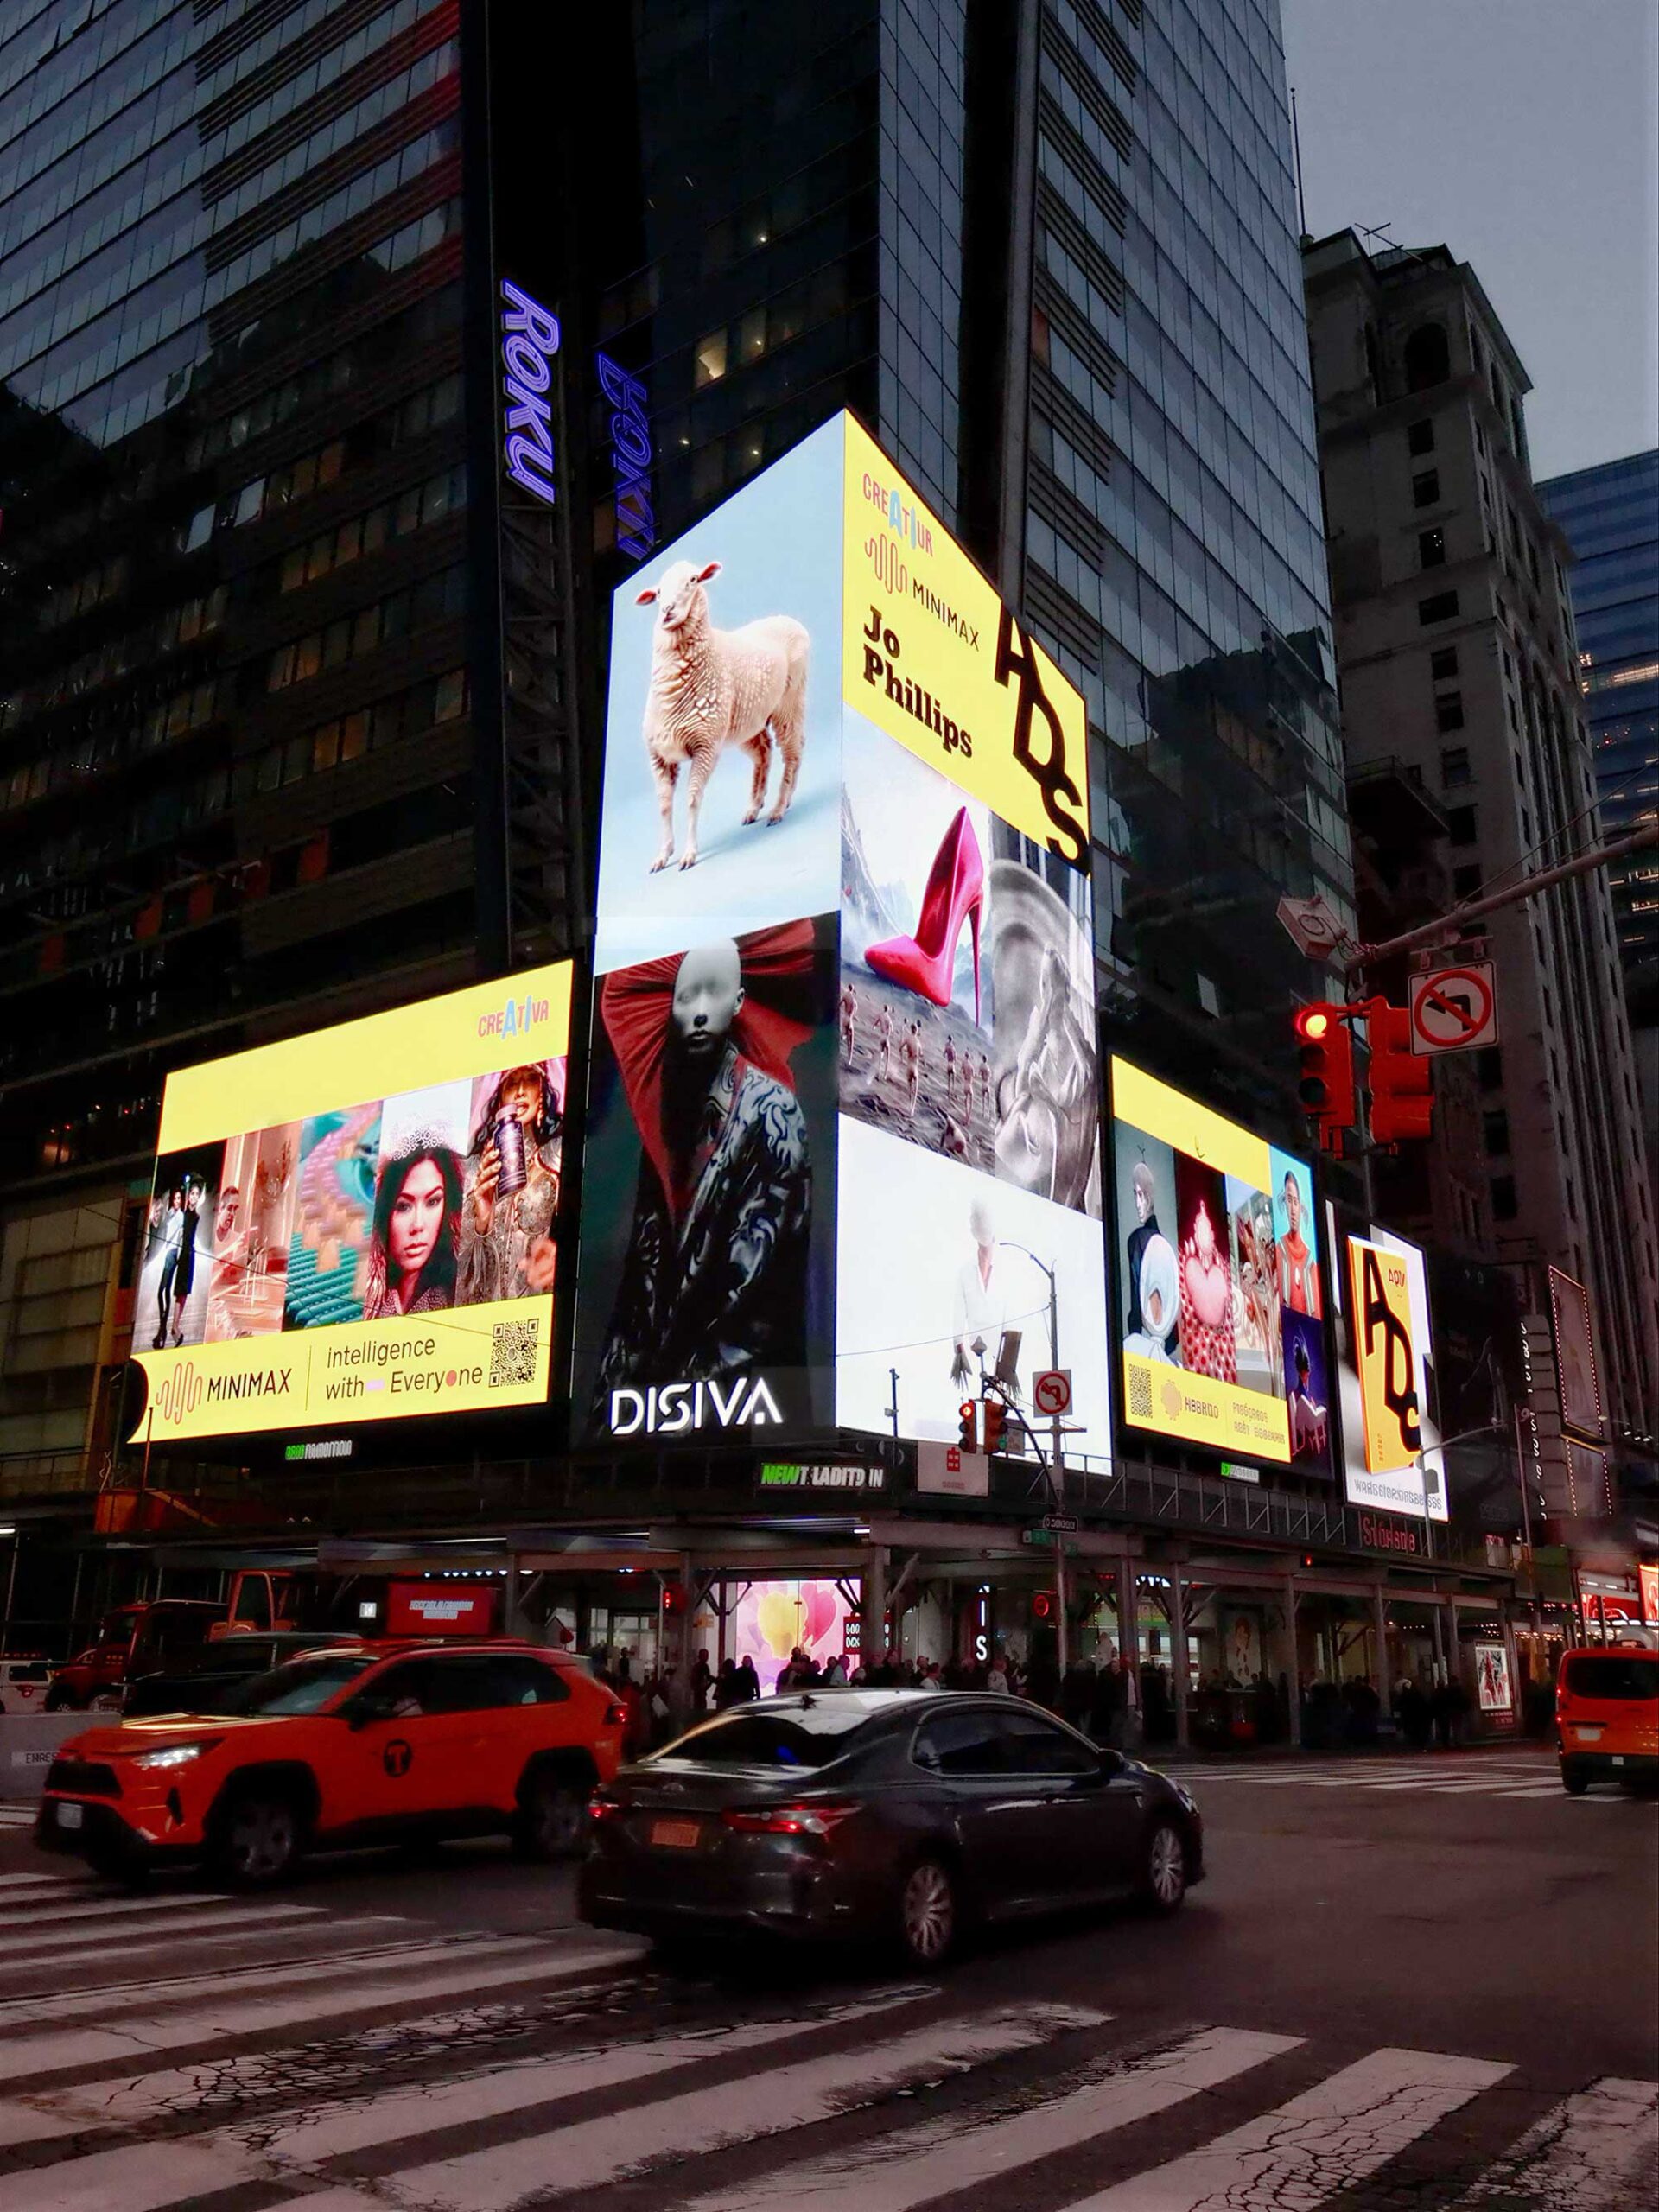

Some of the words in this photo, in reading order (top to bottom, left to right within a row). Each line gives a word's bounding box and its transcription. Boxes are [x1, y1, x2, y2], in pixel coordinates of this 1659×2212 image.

[500, 276, 561, 505] ROKU
[863, 604, 900, 658] Jo
[912, 577, 979, 652] MINIMAX
[862, 643, 972, 758] Phillips
[478, 995, 549, 1040] CREATIVA
[327, 1338, 435, 1368] intelligence
[207, 1368, 292, 1402] MINIMAX
[326, 1375, 365, 1400] with
[610, 1376, 784, 1435] DISIVA
